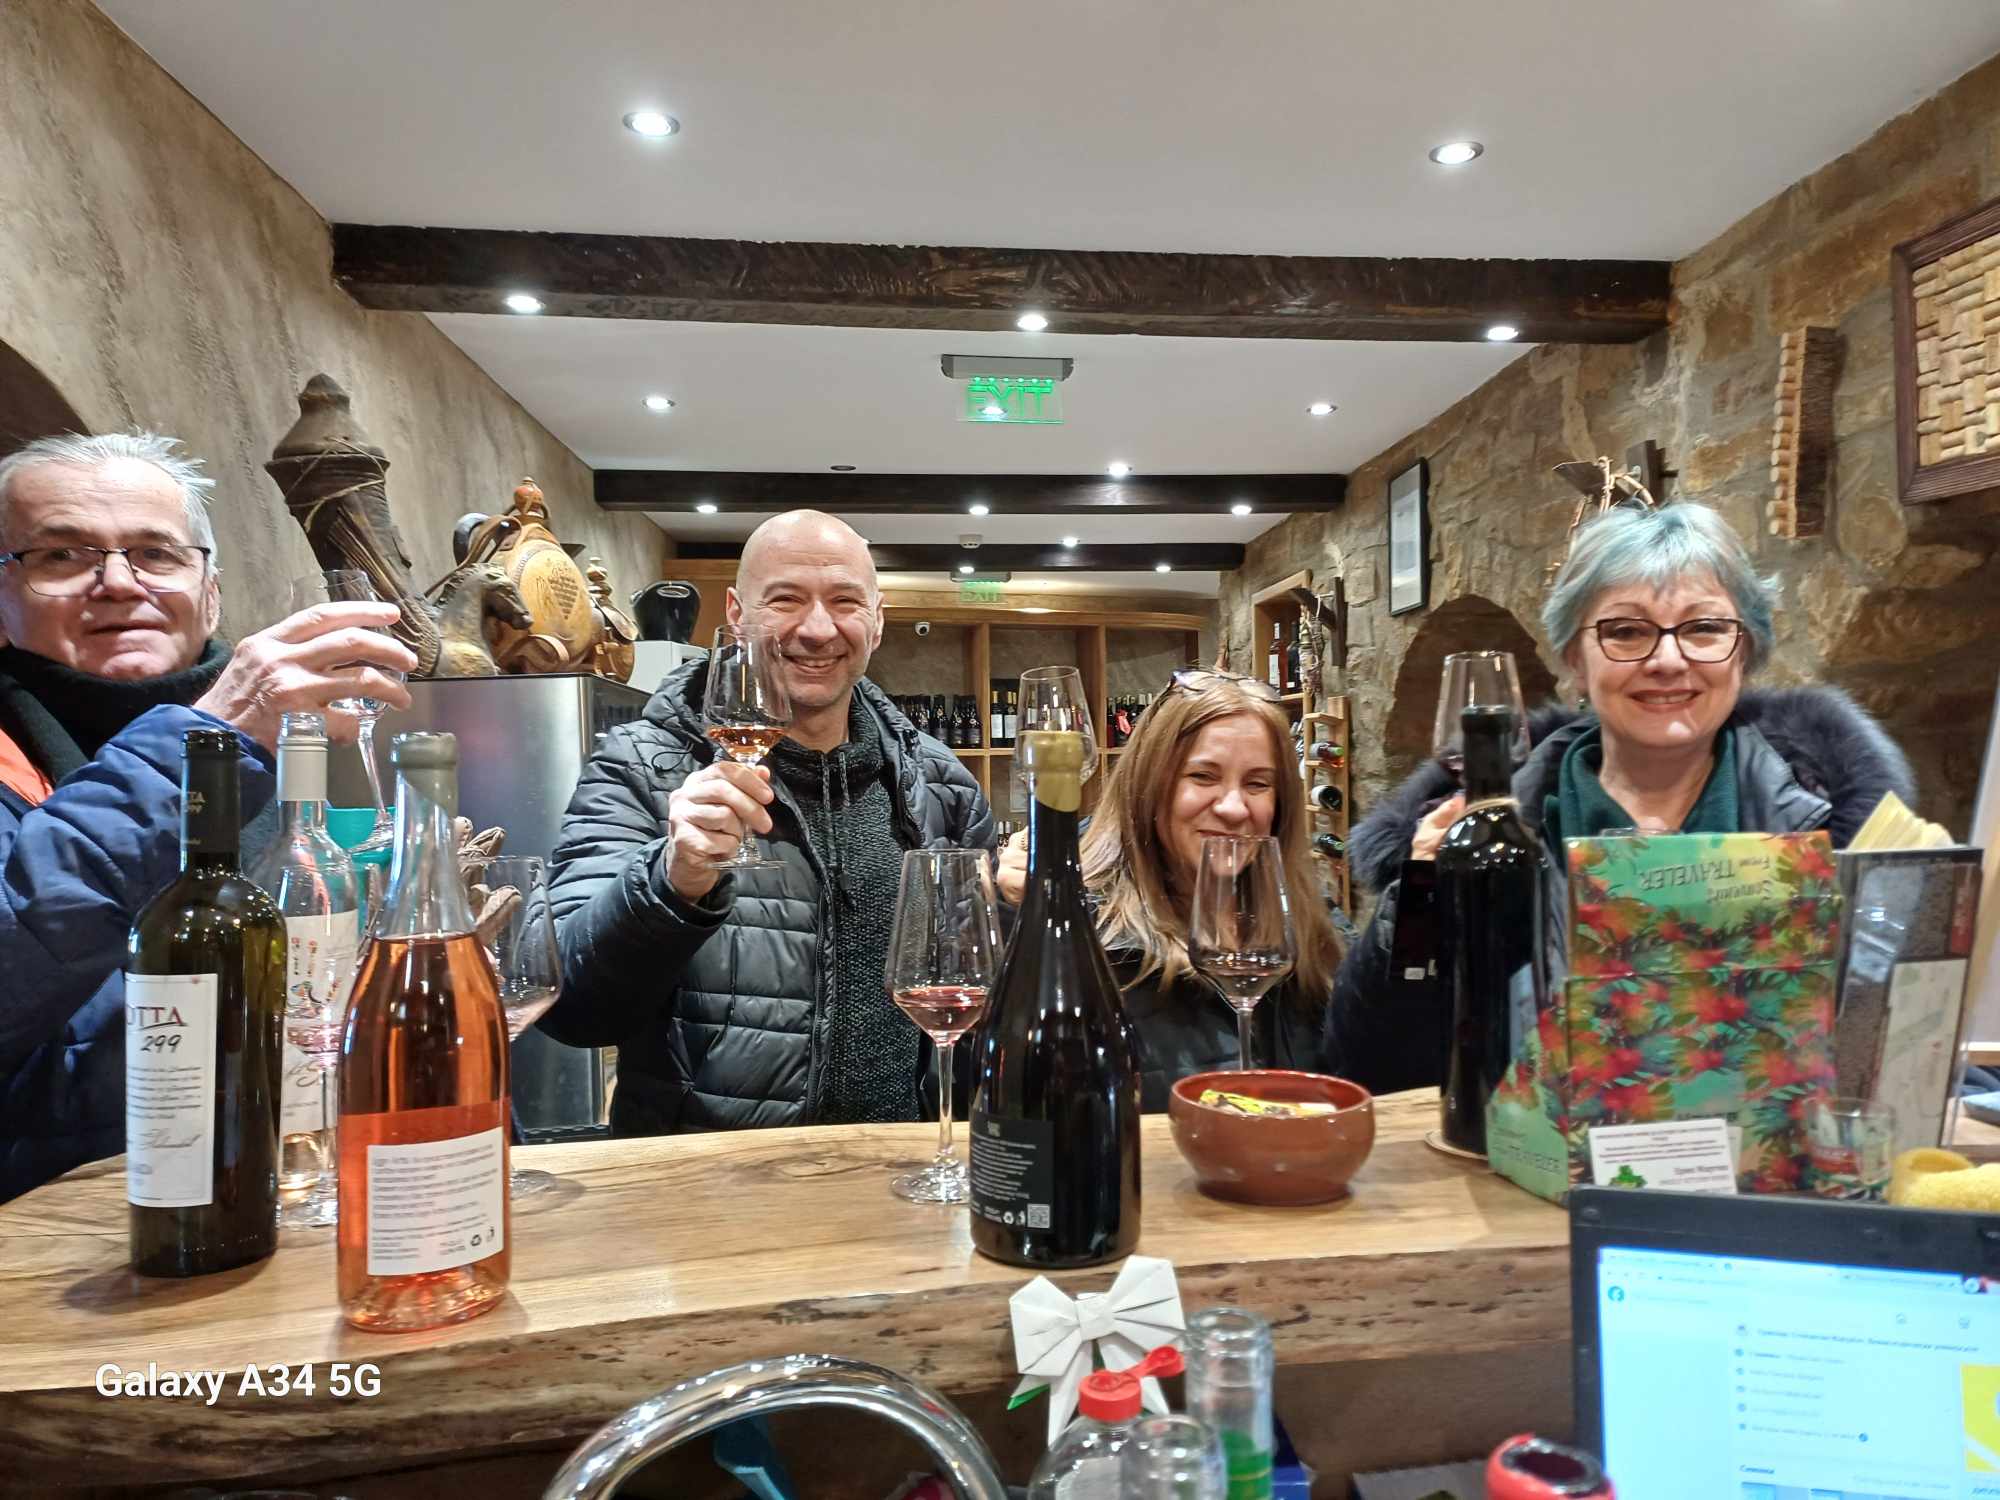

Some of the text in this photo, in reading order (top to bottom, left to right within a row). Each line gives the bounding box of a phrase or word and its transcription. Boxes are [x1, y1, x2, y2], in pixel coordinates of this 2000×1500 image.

[968, 384, 1052, 417] EXIT
[1640, 860, 1735, 892] TRAVELER
[141, 1034, 182, 1054] 299
